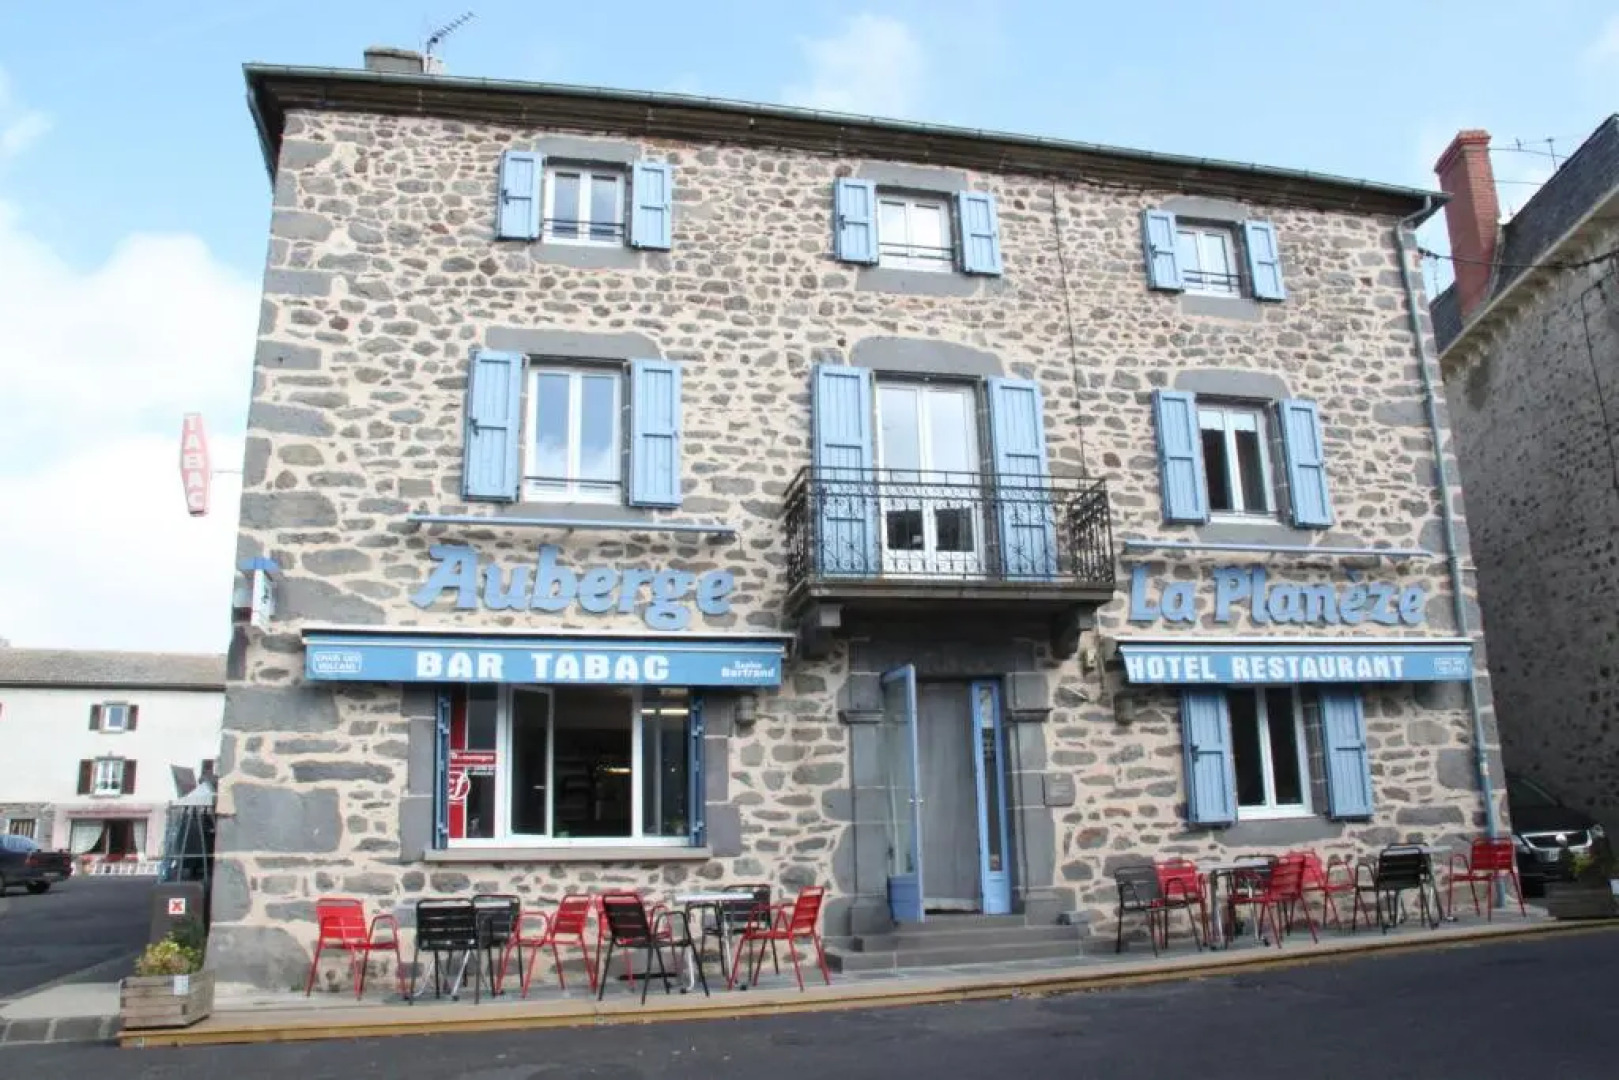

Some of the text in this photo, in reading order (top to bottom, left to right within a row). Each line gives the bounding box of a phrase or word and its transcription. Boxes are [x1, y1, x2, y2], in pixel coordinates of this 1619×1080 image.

[410, 543, 735, 630] Auberge
[1129, 562, 1426, 626] La Planèze
[416, 651, 670, 681] BAR TABAC
[1125, 655, 1217, 682] HOTEL
[1230, 655, 1405, 680] RESTAURANT
